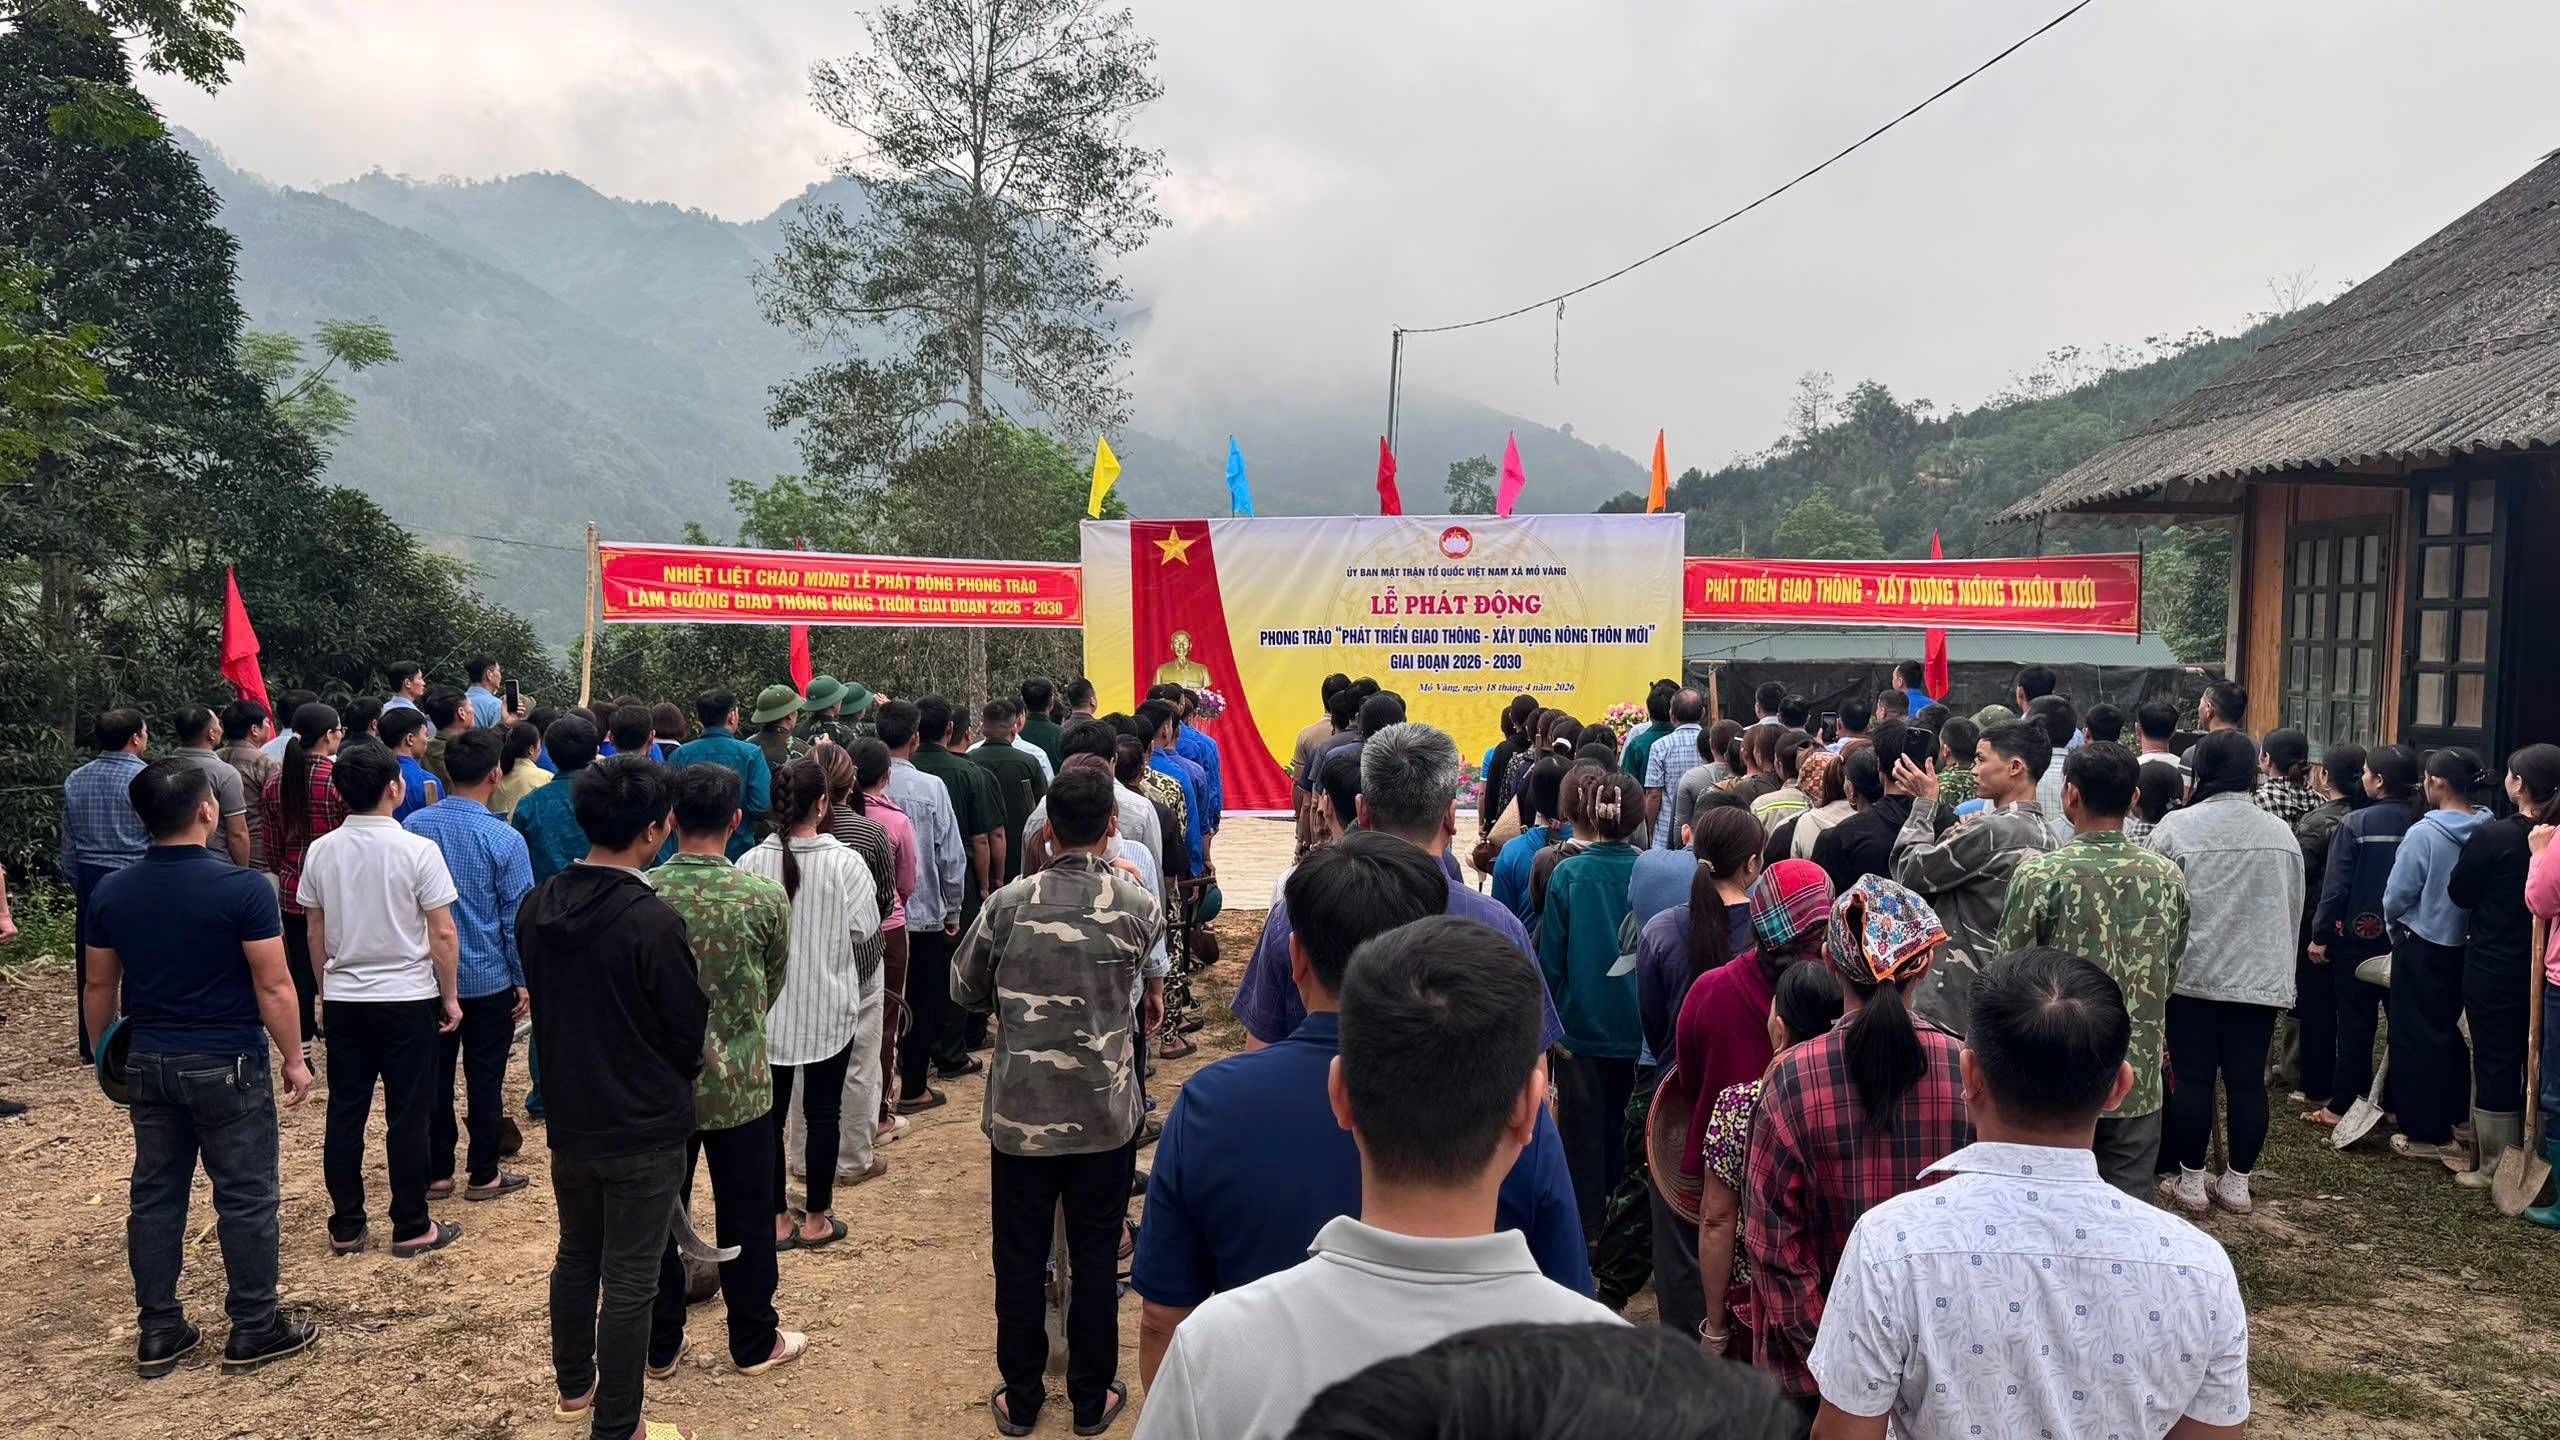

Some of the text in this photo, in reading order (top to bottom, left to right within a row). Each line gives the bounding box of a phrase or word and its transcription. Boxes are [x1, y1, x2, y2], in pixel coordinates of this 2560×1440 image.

[663, 563, 1037, 594] NHIỆT LIỆT CHÀO MỪNG LỄ PHÁT ĐỘNG PHONG TRÀO
[1346, 566, 1357, 577] ỦY
[1360, 568, 1378, 576] BAN
[1402, 567, 1424, 578] TRẬN
[1441, 566, 1464, 577] QUỐC
[1467, 566, 1486, 578] VIỆT
[1488, 568, 1508, 576] NAM
[1511, 566, 1523, 576] XÃ
[1526, 564, 1540, 576] MỎ
[1542, 566, 1567, 576] VÀNG
[628, 586, 666, 607] LÀM
[670, 588, 729, 608] ĐƯỜNG
[734, 592, 772, 610] GIAO
[777, 591, 828, 610] THÔNG
[831, 592, 874, 612] NÔNG
[878, 594, 915, 612] THÔN
[919, 599, 947, 613] GIAI
[950, 599, 987, 616] ĐOẠN
[991, 600, 1021, 614] 2026
[1033, 600, 1063, 615] 2030
[1371, 585, 1542, 618] LỄ PHÁT ĐỘNG
[1705, 574, 1738, 603] PHÁT
[1739, 569, 1777, 603] TRIỂN
[1780, 578, 1812, 603] GIAO
[1815, 573, 1862, 604] THÔNG
[1875, 573, 1905, 605] XÂY
[1910, 577, 1953, 611] DỰNG
[1958, 574, 2005, 606] NÔNG
[2009, 573, 2056, 607] THÔN
[2060, 575, 2096, 609] MỚI
[1260, 630, 1299, 645] PHONG
[1302, 627, 1331, 645] TRÀO
[1374, 623, 1408, 643] TRIỂN
[1411, 628, 1438, 643] GIAO
[1442, 626, 1480, 643] THÔNG
[1492, 626, 1515, 643] XÂY
[1519, 627, 1551, 646] DỰNG
[1555, 625, 1587, 643] NÔNG
[1591, 625, 1621, 643] THÔN
[1391, 655, 1413, 669] GIAI
[1417, 655, 1449, 672] ĐOẠN
[1453, 655, 1481, 669] 2026
[1493, 655, 1522, 669] 2030
[1486, 683, 1496, 691] 18
[1498, 683, 1523, 693] tháng
[1525, 683, 1531, 691] 4
[1554, 683, 1575, 691] 2026
